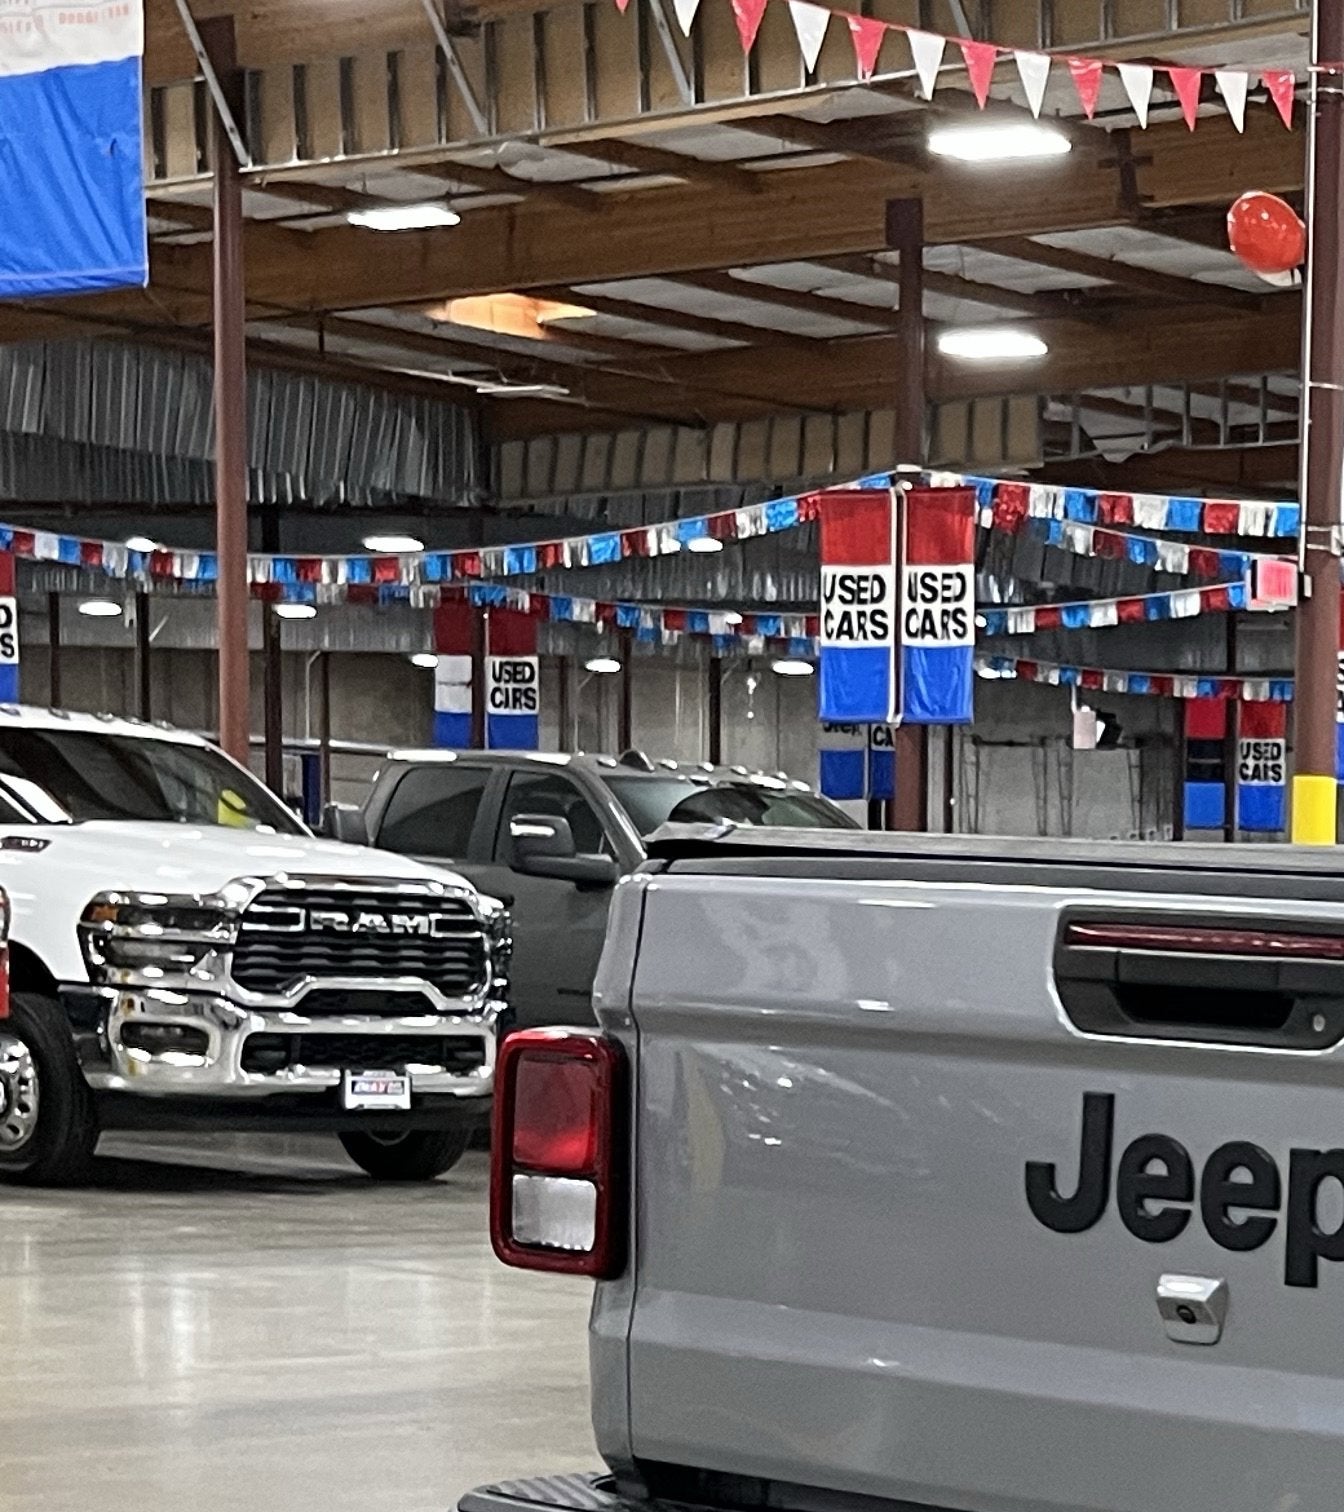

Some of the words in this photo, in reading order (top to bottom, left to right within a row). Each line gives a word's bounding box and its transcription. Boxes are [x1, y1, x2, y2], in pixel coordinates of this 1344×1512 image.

[823, 573, 886, 605] USED
[907, 571, 967, 604] USED
[823, 608, 889, 640] CARS
[905, 607, 968, 640] CARS
[491, 660, 535, 684] USED
[1240, 742, 1281, 760] USED
[309, 910, 429, 934] RAM
